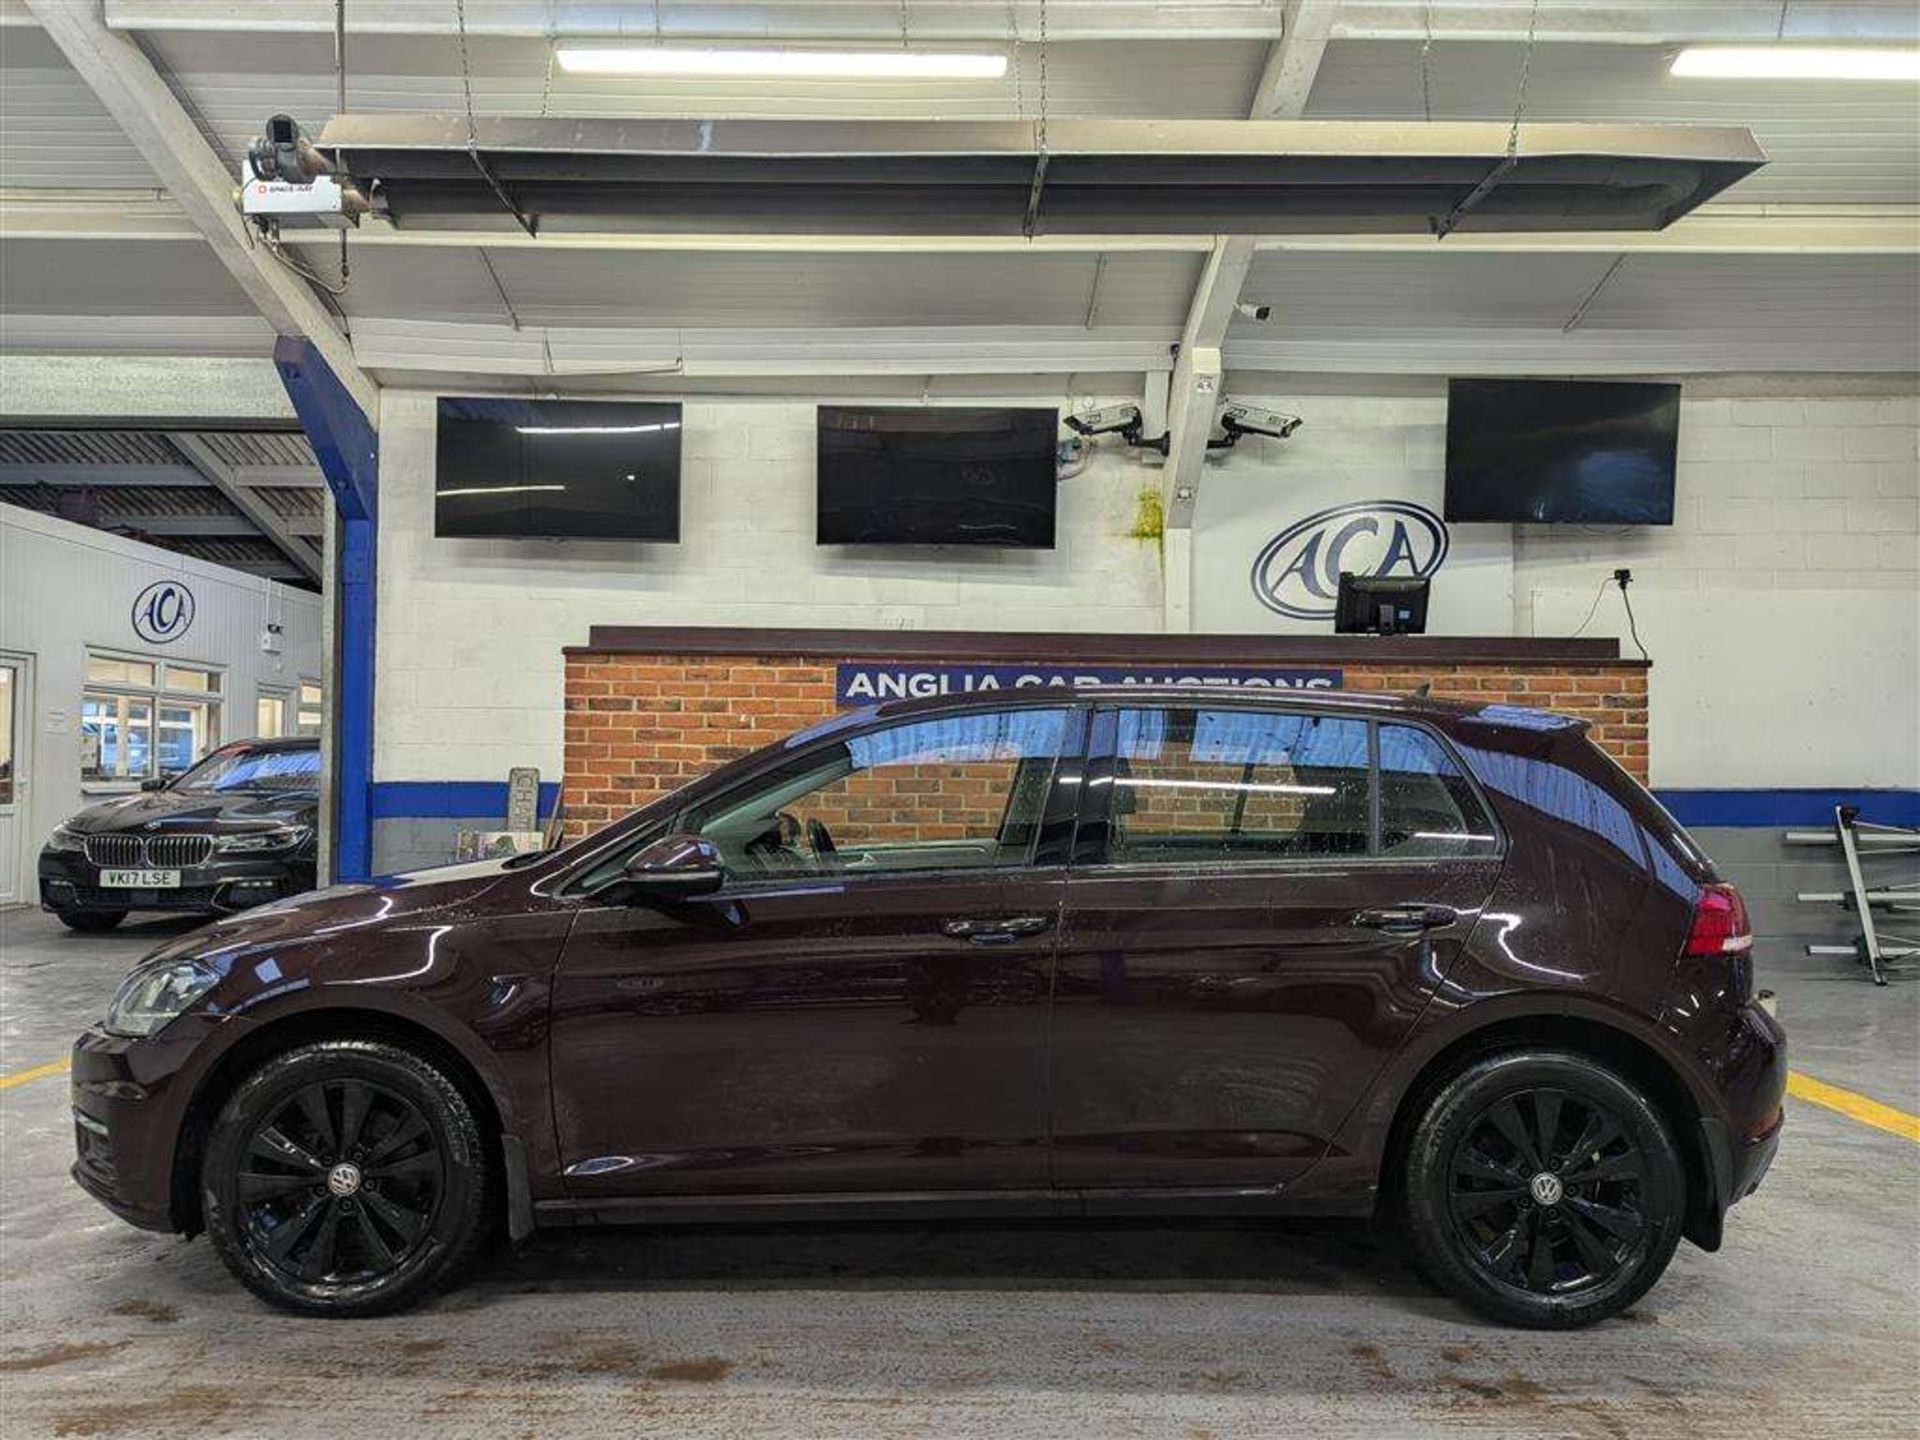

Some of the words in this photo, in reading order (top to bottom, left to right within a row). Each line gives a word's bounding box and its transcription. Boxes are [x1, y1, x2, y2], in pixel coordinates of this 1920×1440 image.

[1270, 516, 1419, 600] ACA
[137, 587, 188, 634] ACA
[845, 672, 1000, 698] ANGLIA
